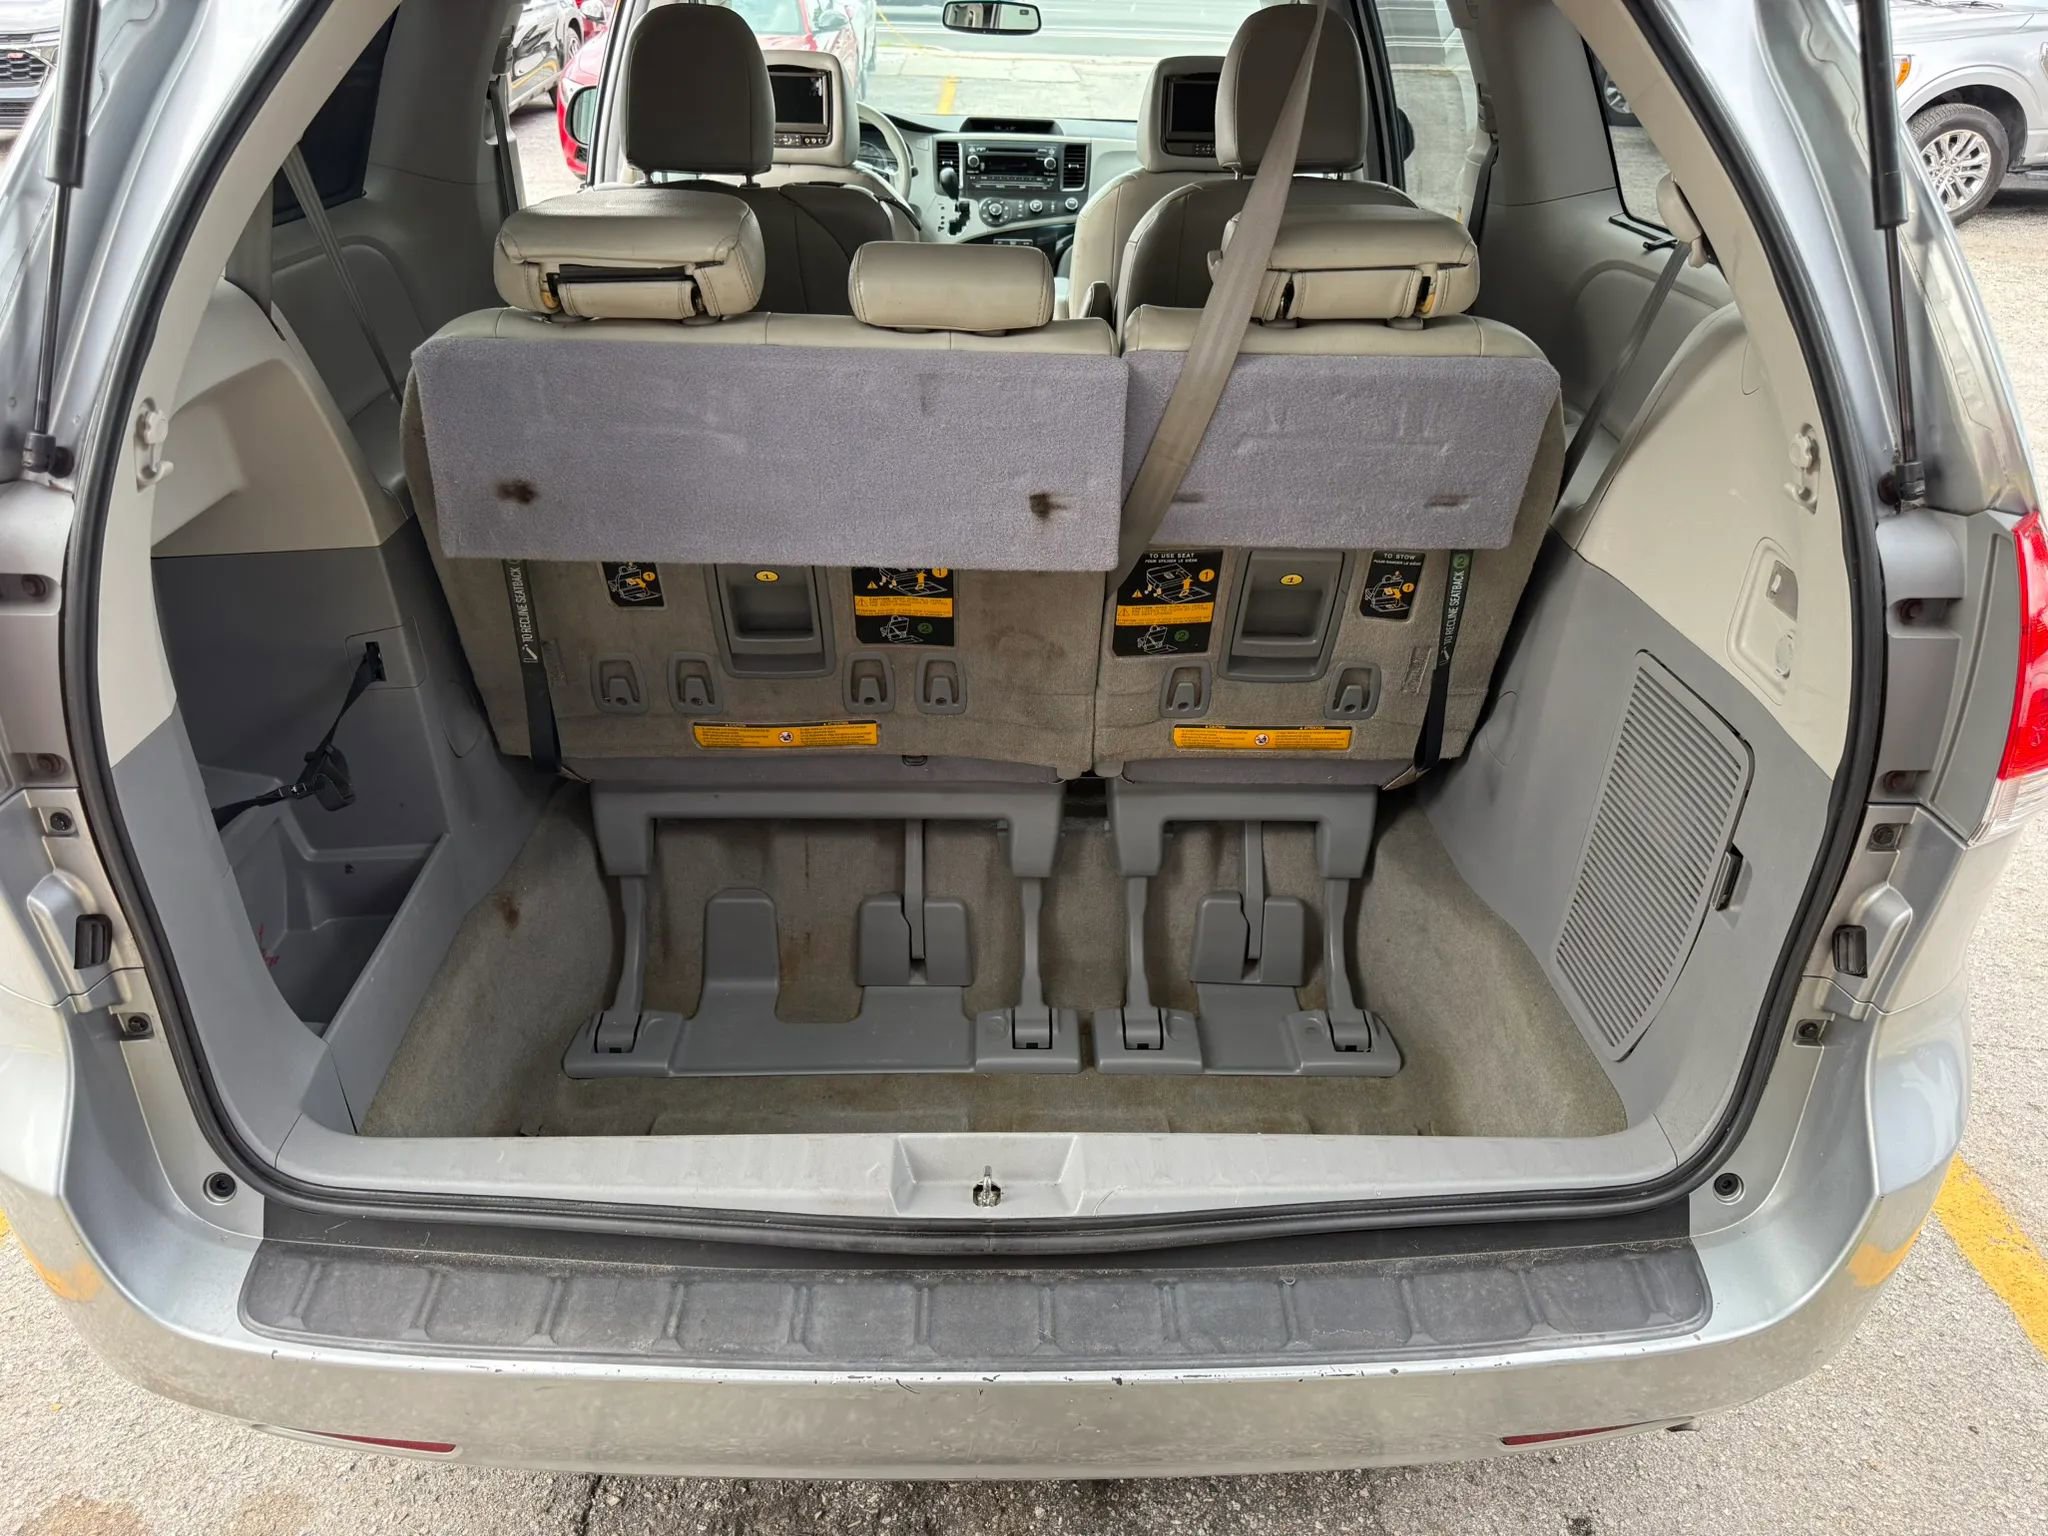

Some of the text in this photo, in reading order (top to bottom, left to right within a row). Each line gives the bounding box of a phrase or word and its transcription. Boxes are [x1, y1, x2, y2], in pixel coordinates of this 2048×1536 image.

[510, 567, 526, 604] SEATBACK
[1449, 571, 1464, 606] SEATBACK
[517, 604, 532, 633] RECLINE
[1445, 607, 1458, 636] RECLINE
